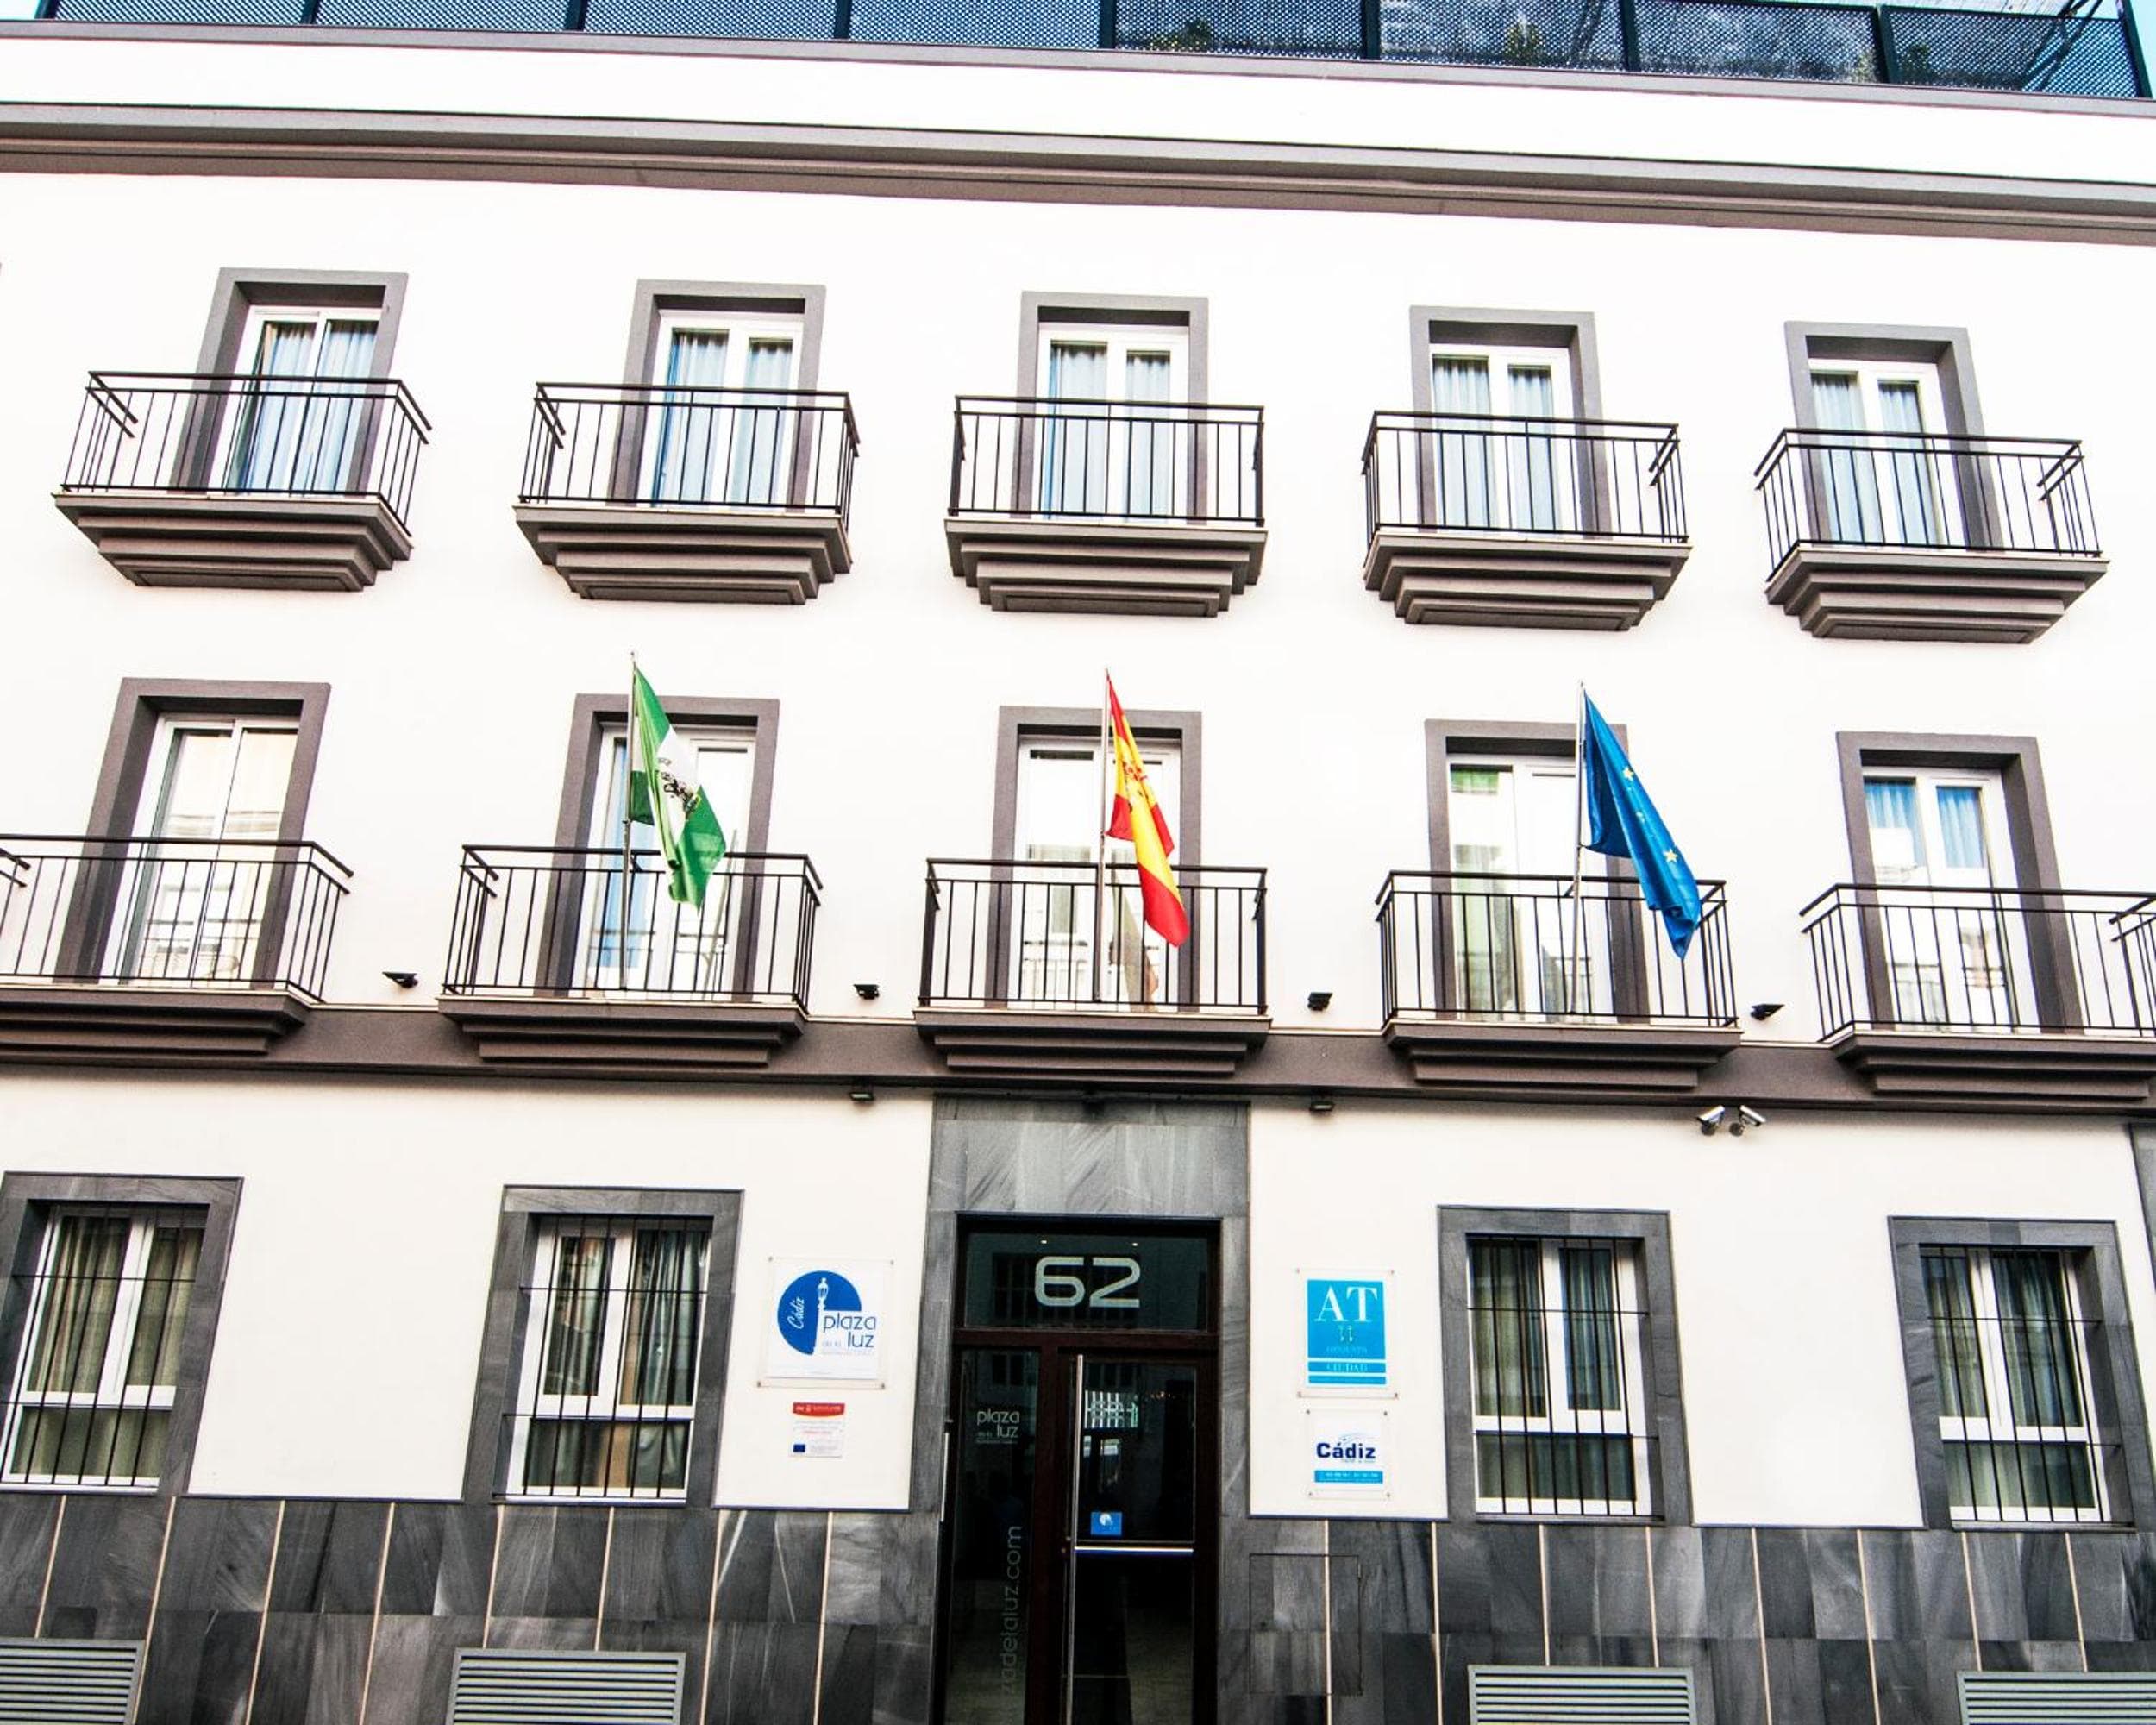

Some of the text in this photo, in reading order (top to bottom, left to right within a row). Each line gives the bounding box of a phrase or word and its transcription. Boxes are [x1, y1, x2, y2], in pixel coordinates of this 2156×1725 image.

[1035, 1257, 1140, 1307] 62
[1314, 1285, 1378, 1322] AT
[823, 1313, 876, 1333] plaza
[847, 1332, 874, 1347] luz
[976, 1408, 1020, 1426] plaza
[996, 1424, 1019, 1438] luz
[1316, 1442, 1376, 1459] Cádiz
